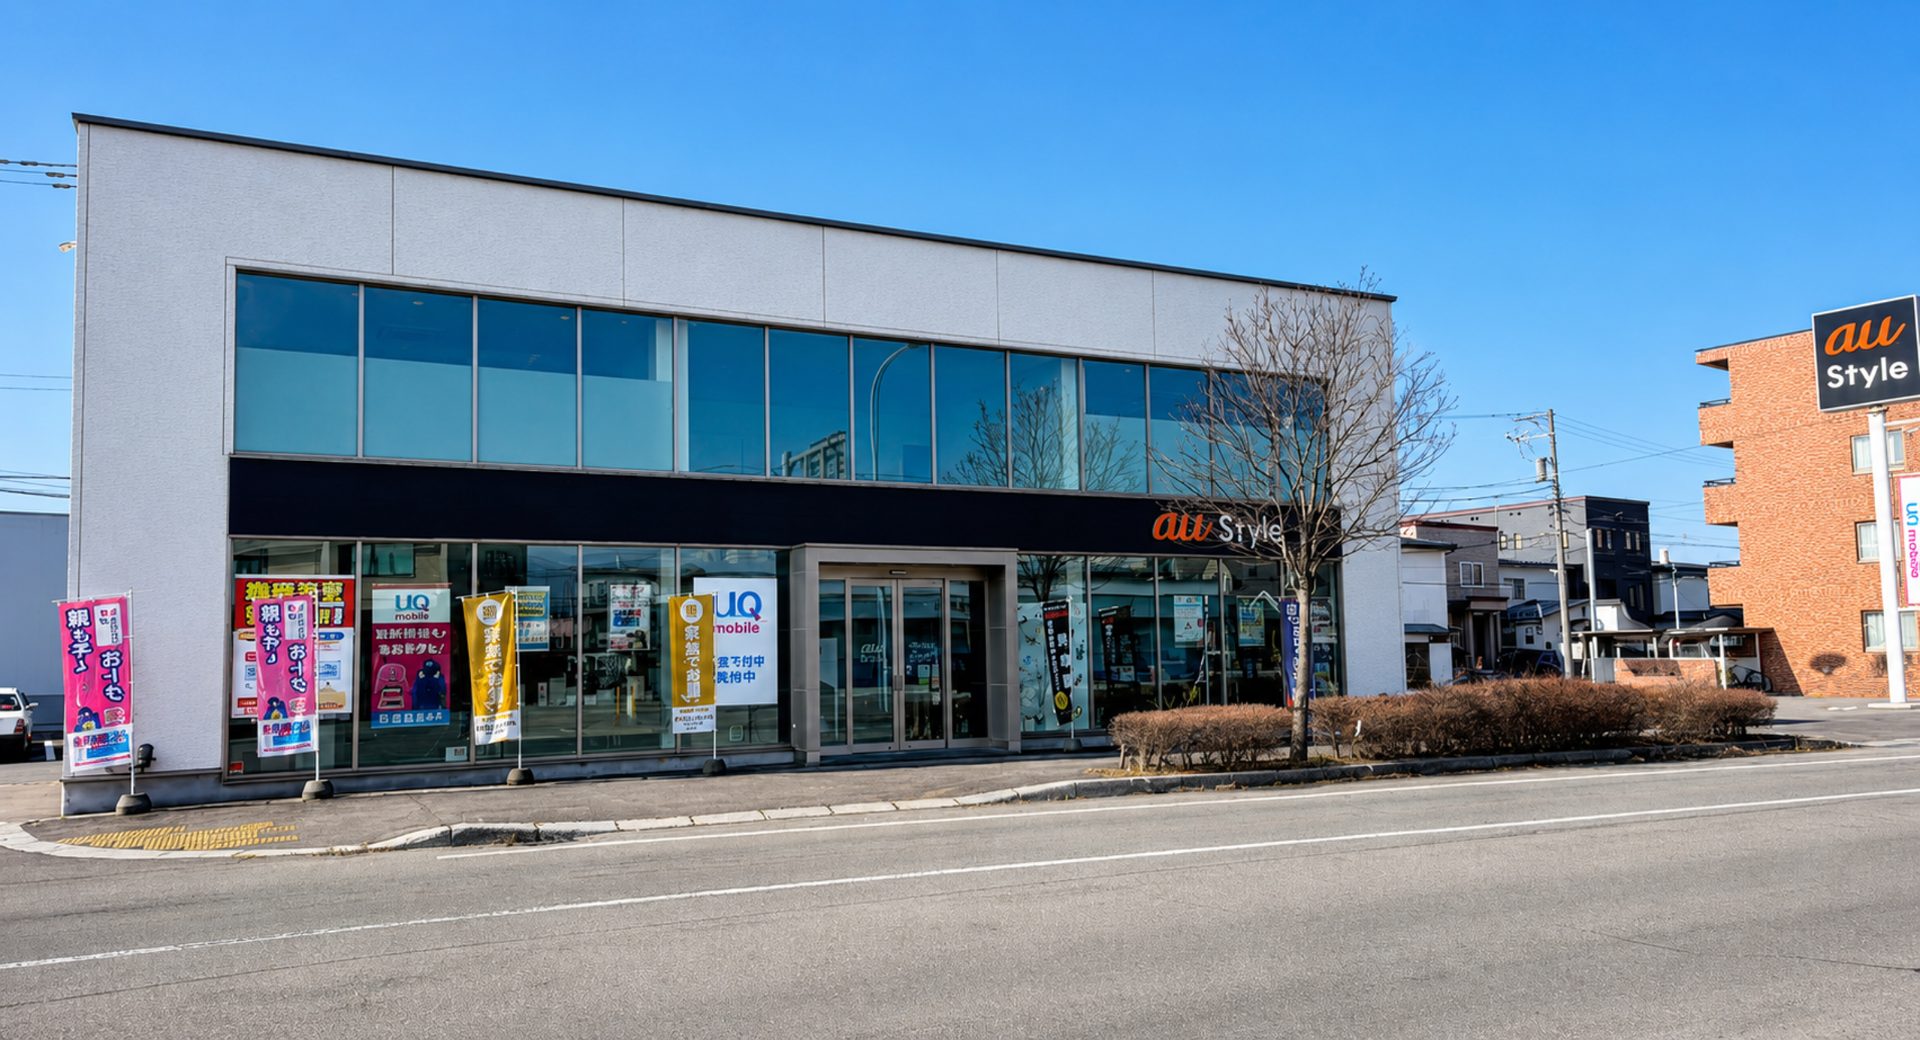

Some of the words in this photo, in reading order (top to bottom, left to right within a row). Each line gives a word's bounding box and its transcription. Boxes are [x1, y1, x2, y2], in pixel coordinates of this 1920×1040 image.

[1824, 315, 1906, 356] au
[1826, 356, 1909, 390] Style
[1152, 511, 1213, 542] au
[1218, 514, 1283, 549] Style
[395, 593, 431, 612] UQ
[395, 612, 430, 621] mobile
[713, 591, 762, 620] UQ
[713, 621, 760, 633] mobile
